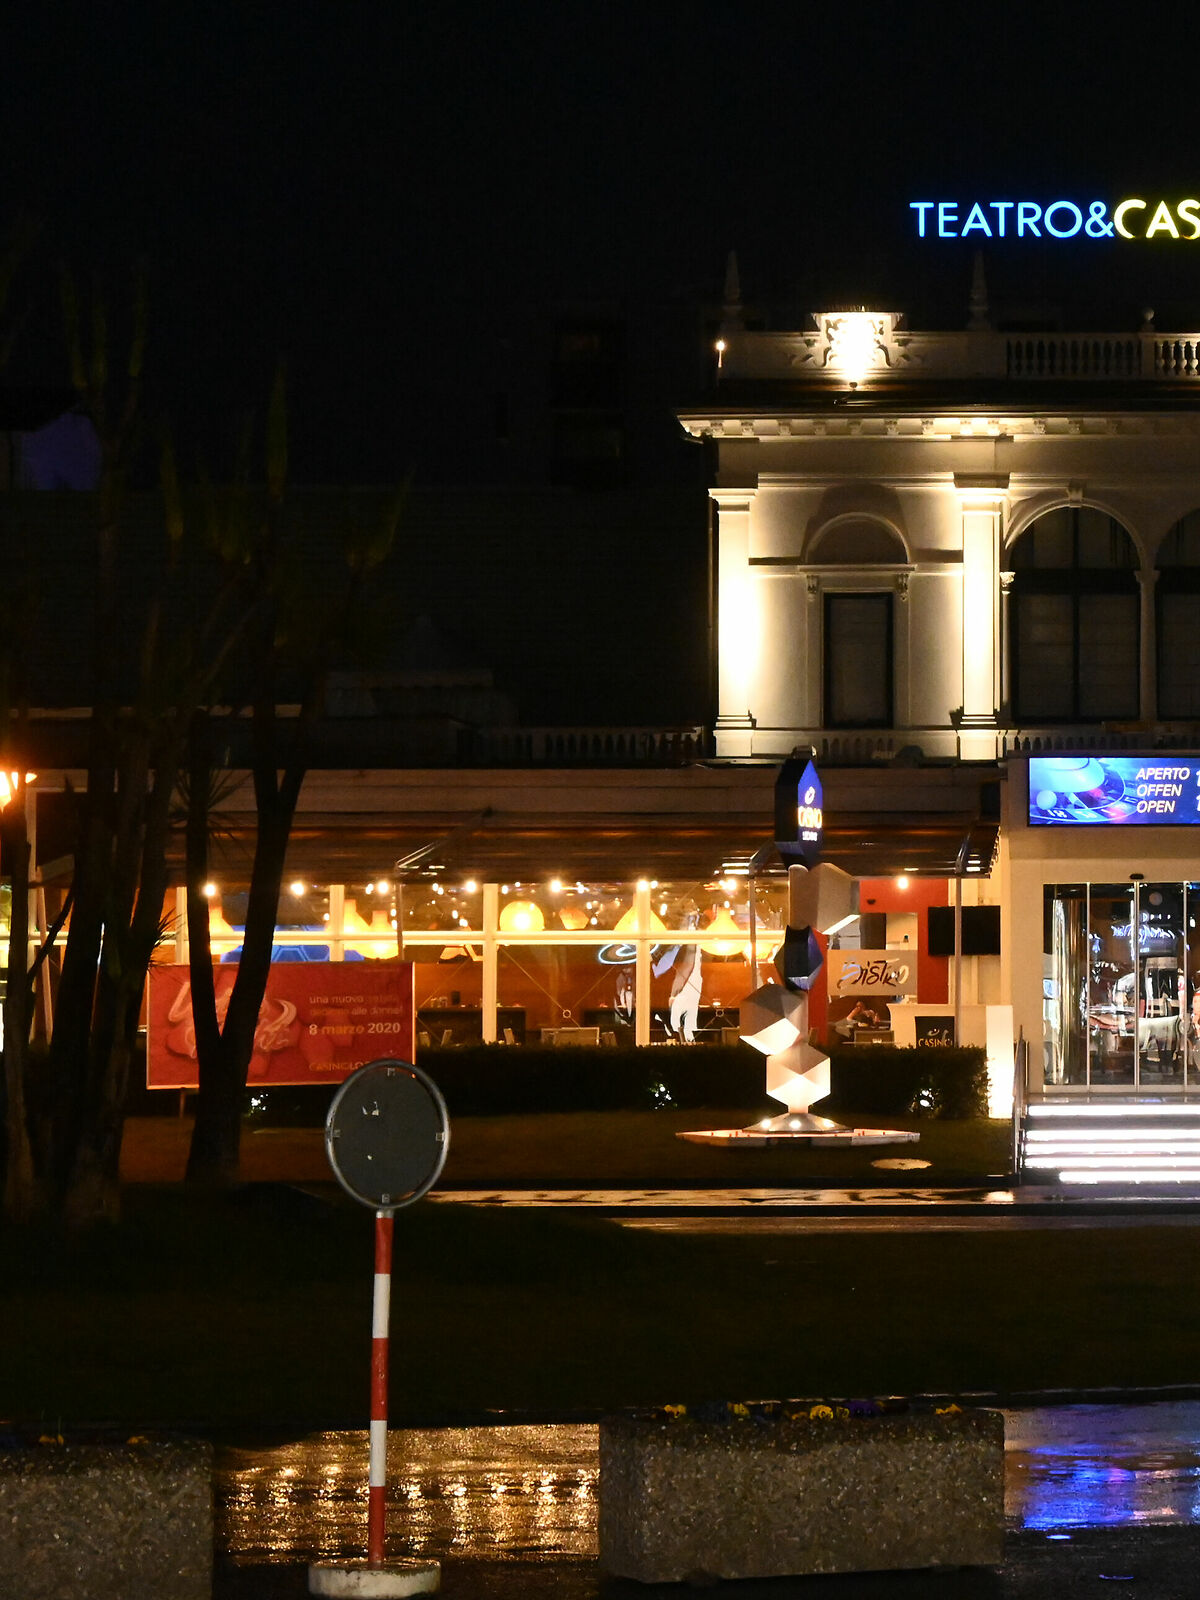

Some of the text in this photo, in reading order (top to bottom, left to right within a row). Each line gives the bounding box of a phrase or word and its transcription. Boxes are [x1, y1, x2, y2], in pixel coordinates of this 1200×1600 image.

[1135, 767, 1190, 780] APERTO
[1136, 784, 1182, 797] OFFEN
[1136, 800, 1176, 814] OPEN
[309, 995, 329, 1004] una
[332, 995, 364, 1004] nuova
[309, 1022, 401, 1036] 8 marzo 2020
